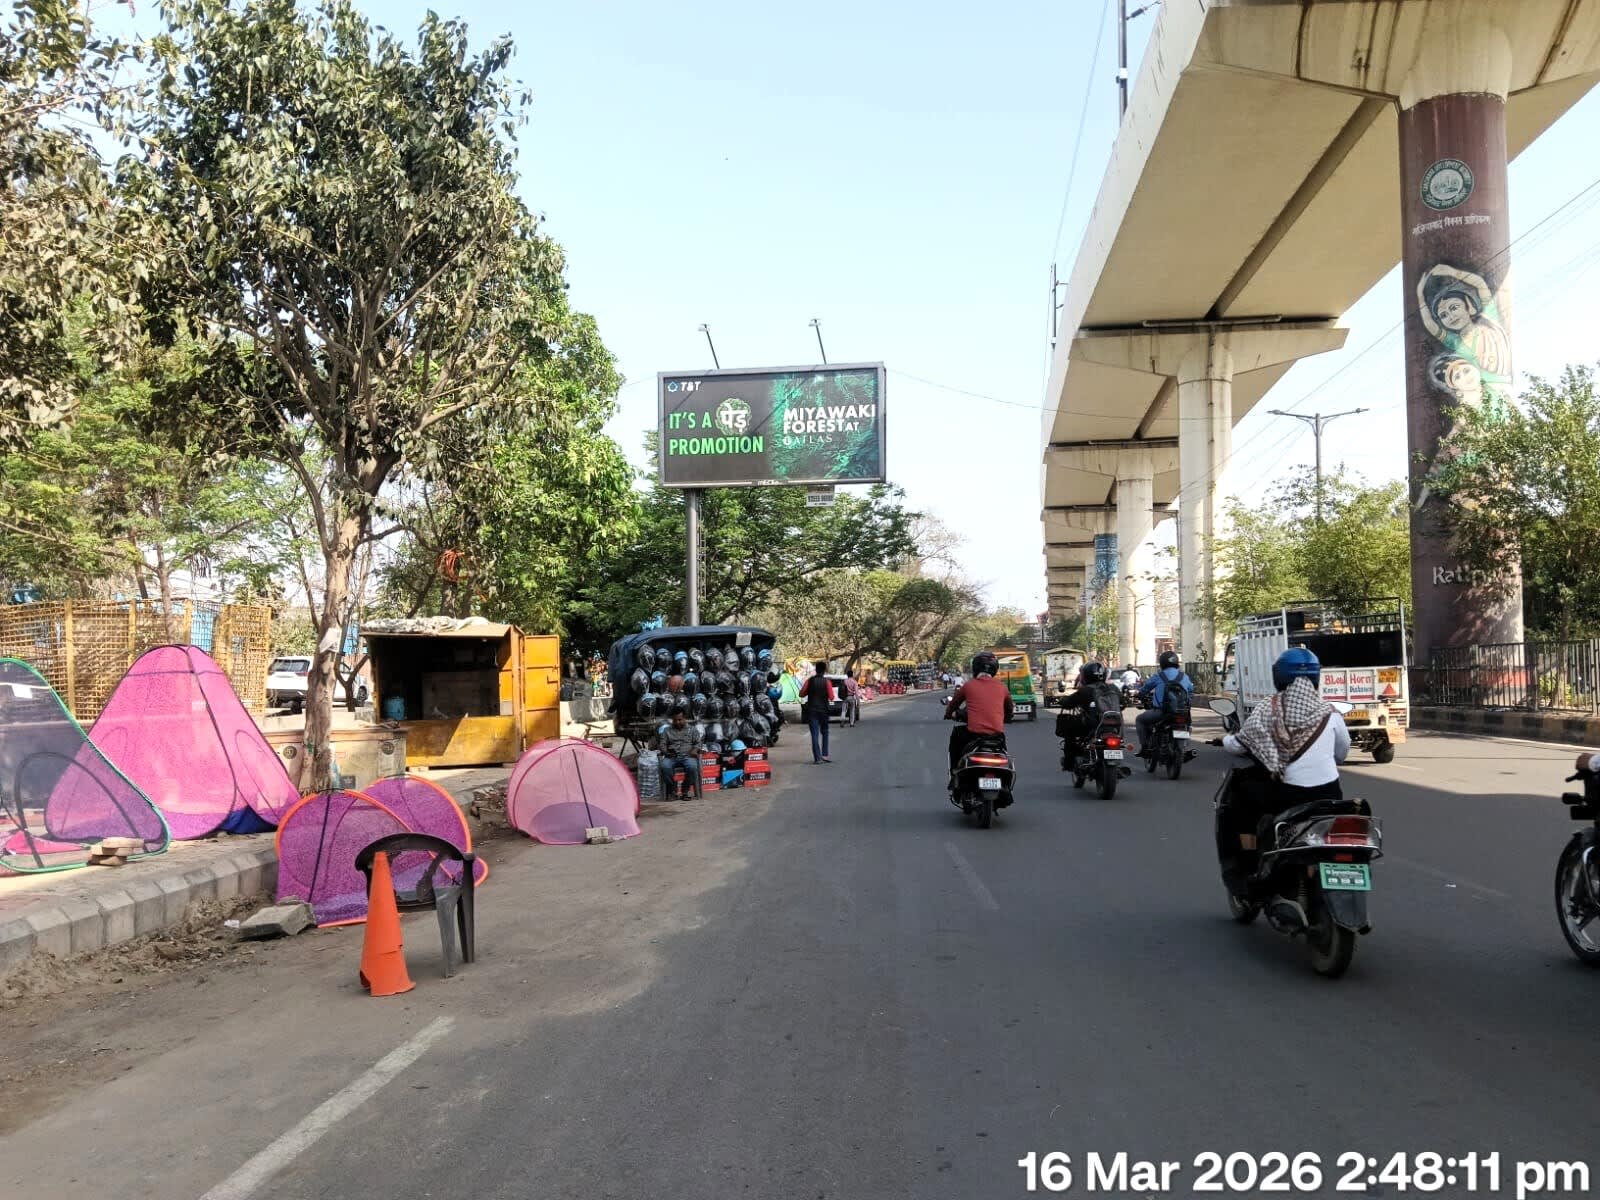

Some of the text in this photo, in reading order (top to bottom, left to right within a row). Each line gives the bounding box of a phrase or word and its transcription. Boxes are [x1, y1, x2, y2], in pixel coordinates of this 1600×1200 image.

[681, 381, 702, 392] T&T
[702, 410, 713, 428] A
[783, 404, 875, 421] MIYAWAKI
[783, 418, 860, 435] FOREST AT
[669, 436, 764, 455] PROMOTION
[794, 433, 833, 445] ATLAS
[1350, 673, 1371, 684] Horn
